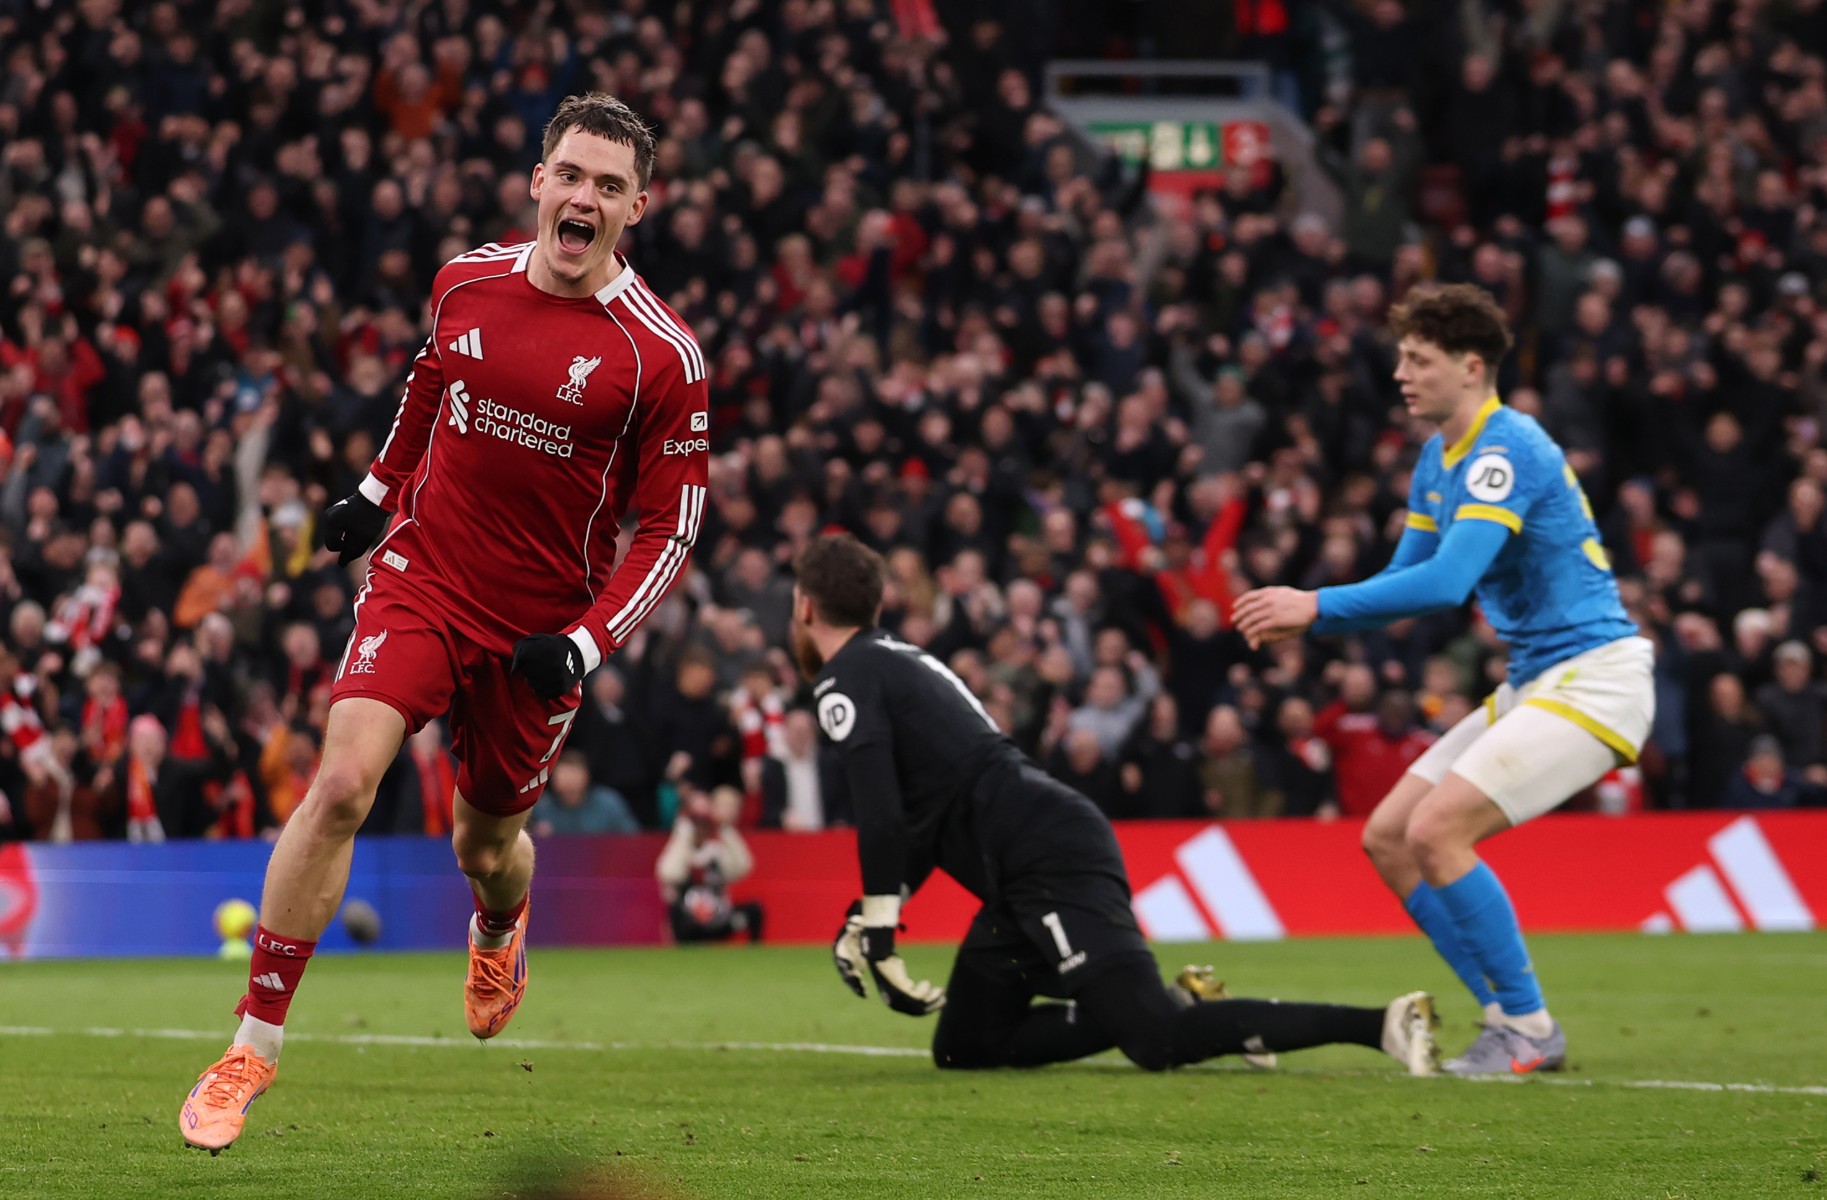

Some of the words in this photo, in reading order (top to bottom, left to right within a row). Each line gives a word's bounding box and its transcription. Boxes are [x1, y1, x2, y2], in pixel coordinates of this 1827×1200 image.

[474, 416, 574, 458] chartered
[476, 398, 571, 441] standard
[1472, 466, 1508, 489] JD
[540, 706, 579, 763] 7
[257, 932, 297, 956] LFC
[1041, 911, 1072, 960] 1
